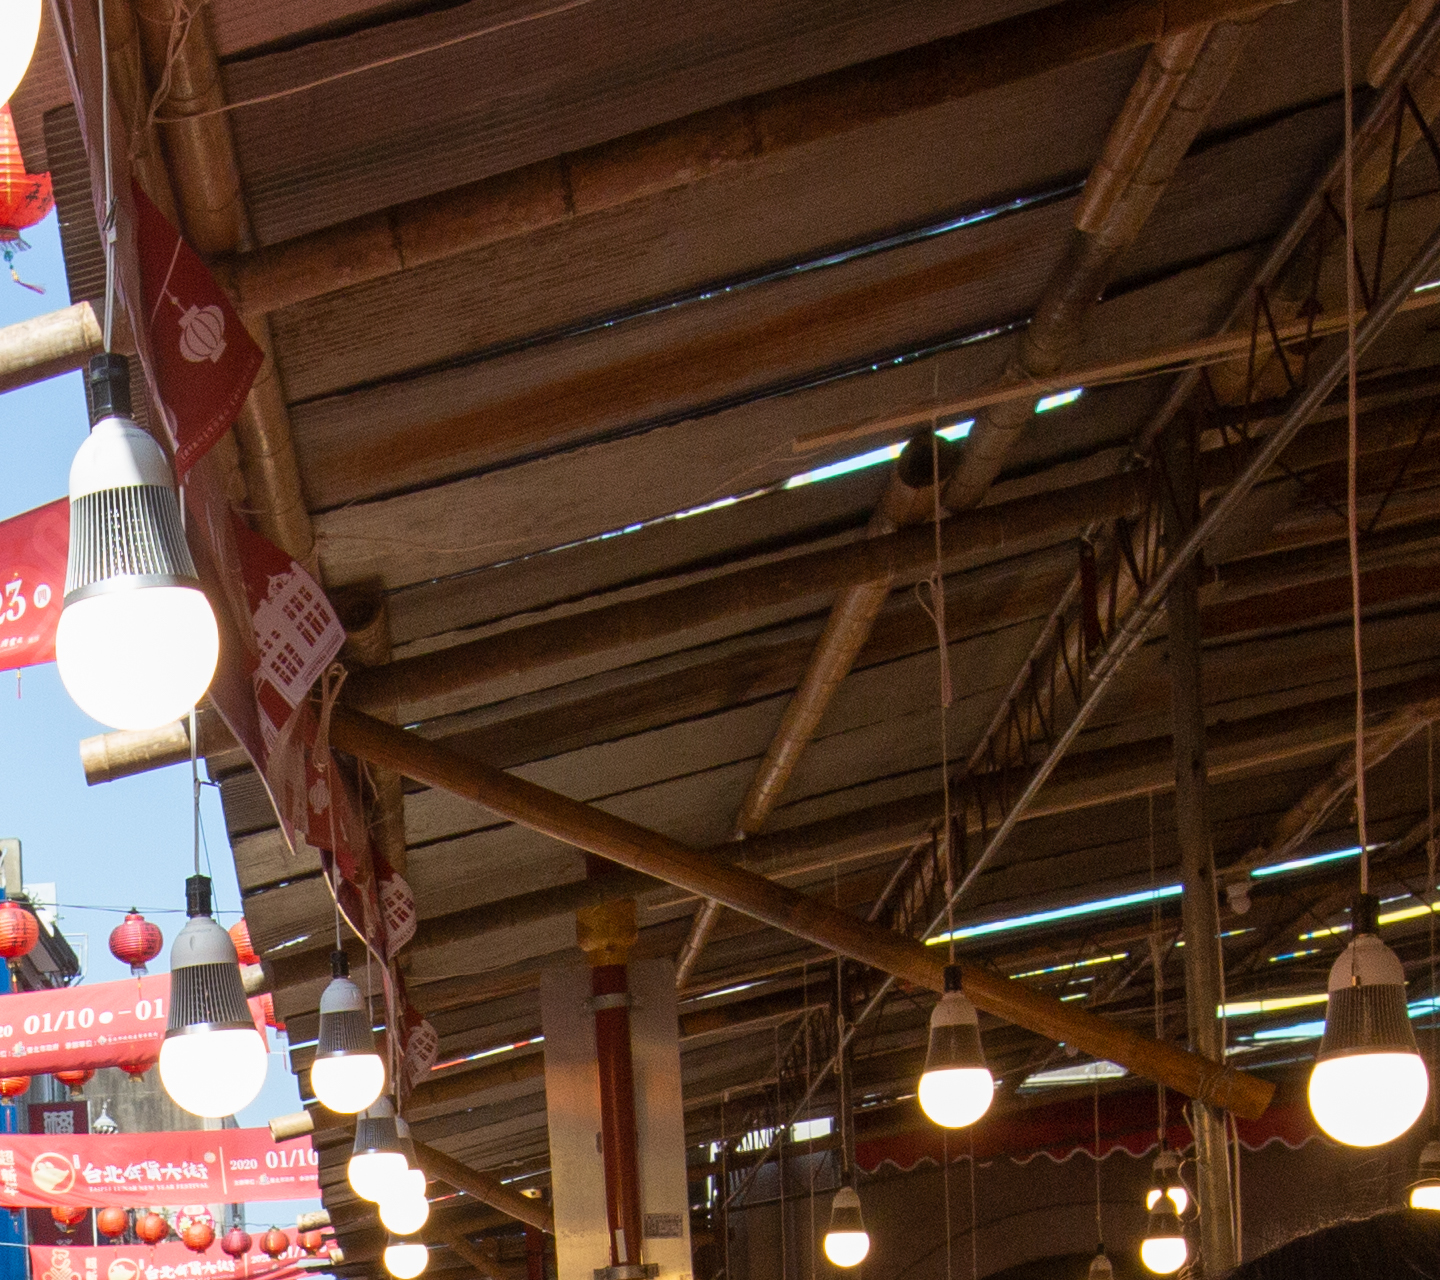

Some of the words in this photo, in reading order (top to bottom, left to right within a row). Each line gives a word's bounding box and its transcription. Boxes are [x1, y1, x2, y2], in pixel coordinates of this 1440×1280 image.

[24, 1007, 94, 1036] 01/10
[82, 1159, 209, 1183] 台北年貨大街
[230, 1158, 258, 1171] 2020
